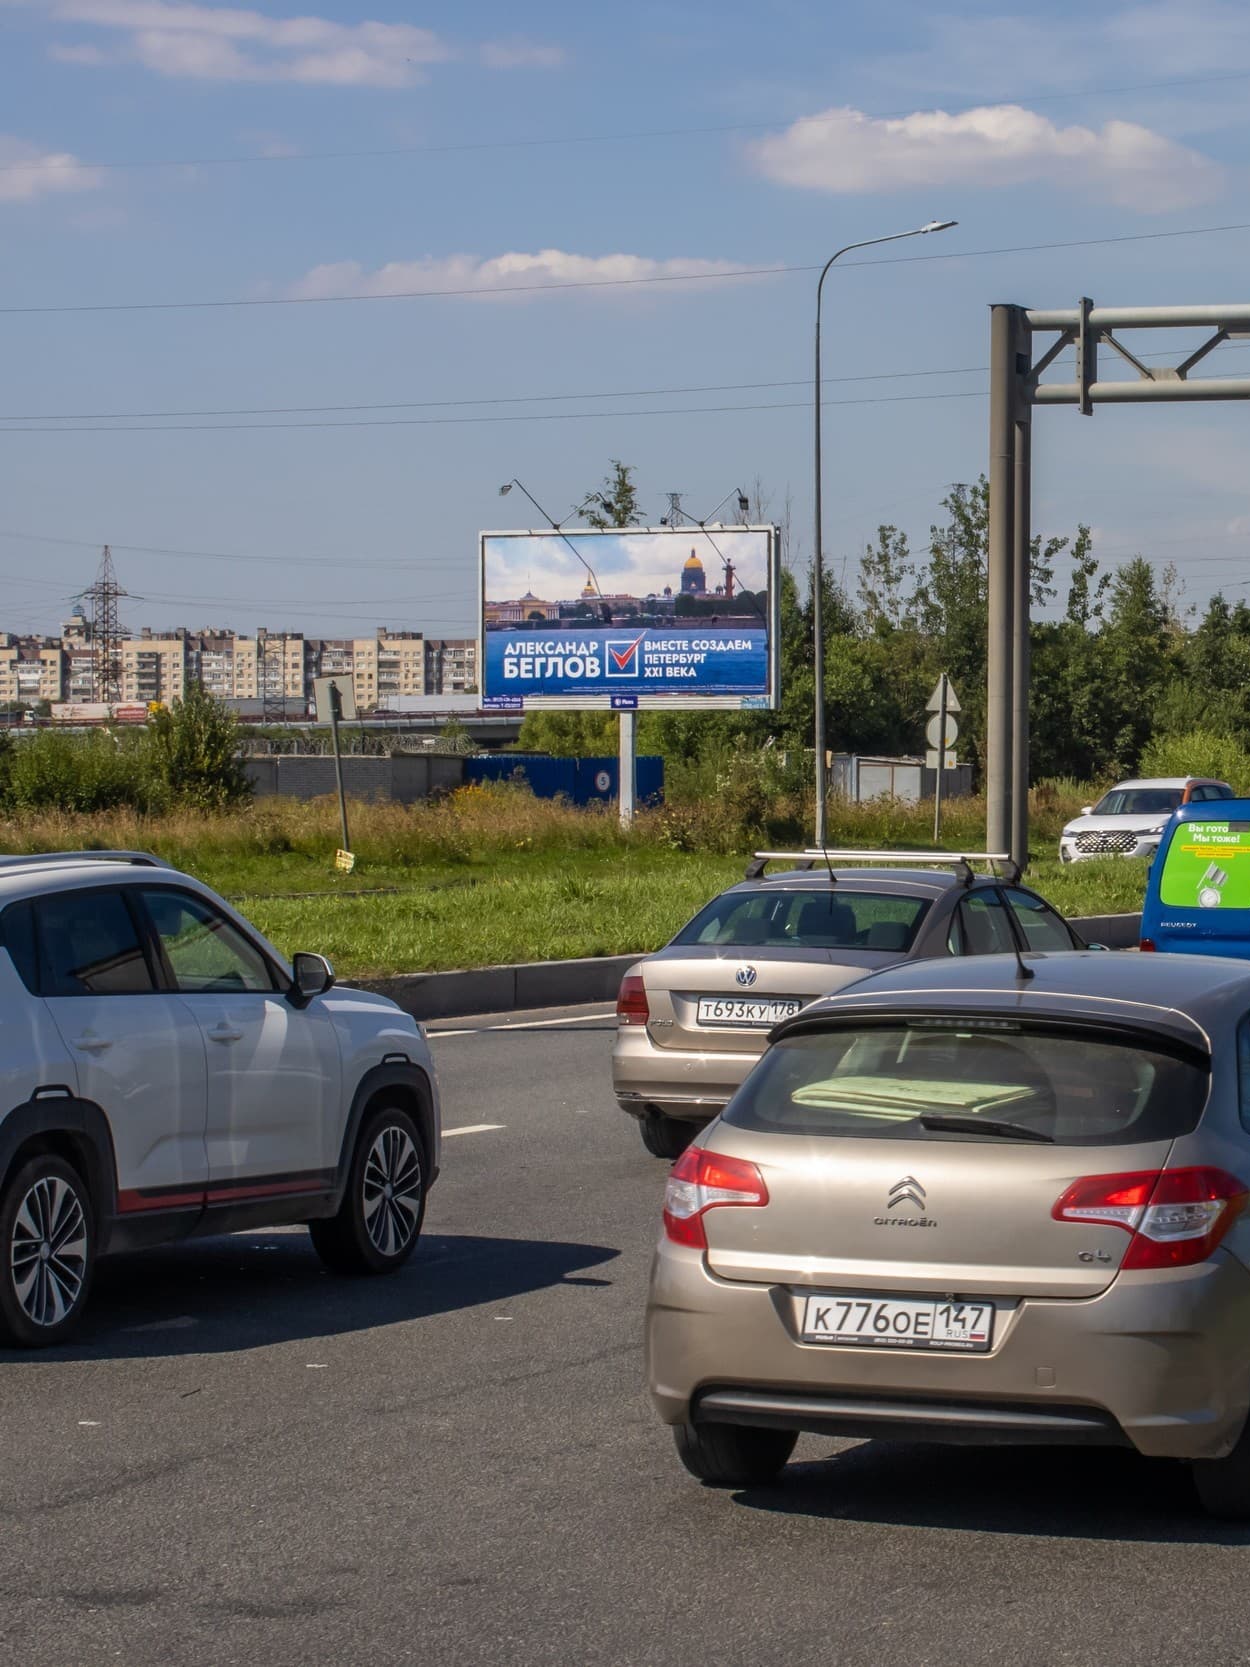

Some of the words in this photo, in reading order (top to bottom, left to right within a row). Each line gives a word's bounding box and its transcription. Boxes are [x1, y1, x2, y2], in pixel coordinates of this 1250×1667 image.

[504, 640, 599, 656] АЛЕКСАНДР
[644, 640, 689, 651] ВМЕСТЕ
[691, 640, 753, 651] СОЗДАЕМ
[644, 653, 707, 665] ПЕТЕРБУРГ
[503, 657, 601, 679] БЕГЛОВ
[665, 666, 697, 678] ВЕКА
[1188, 823, 1204, 833] Вы
[1193, 834, 1210, 842] Мы
[1211, 835, 1240, 843] тоже!
[771, 1002, 795, 1016] 178
[1077, 1250, 1112, 1264] C4
[938, 1305, 985, 1330] 147
[946, 1329, 969, 1339] RUS
